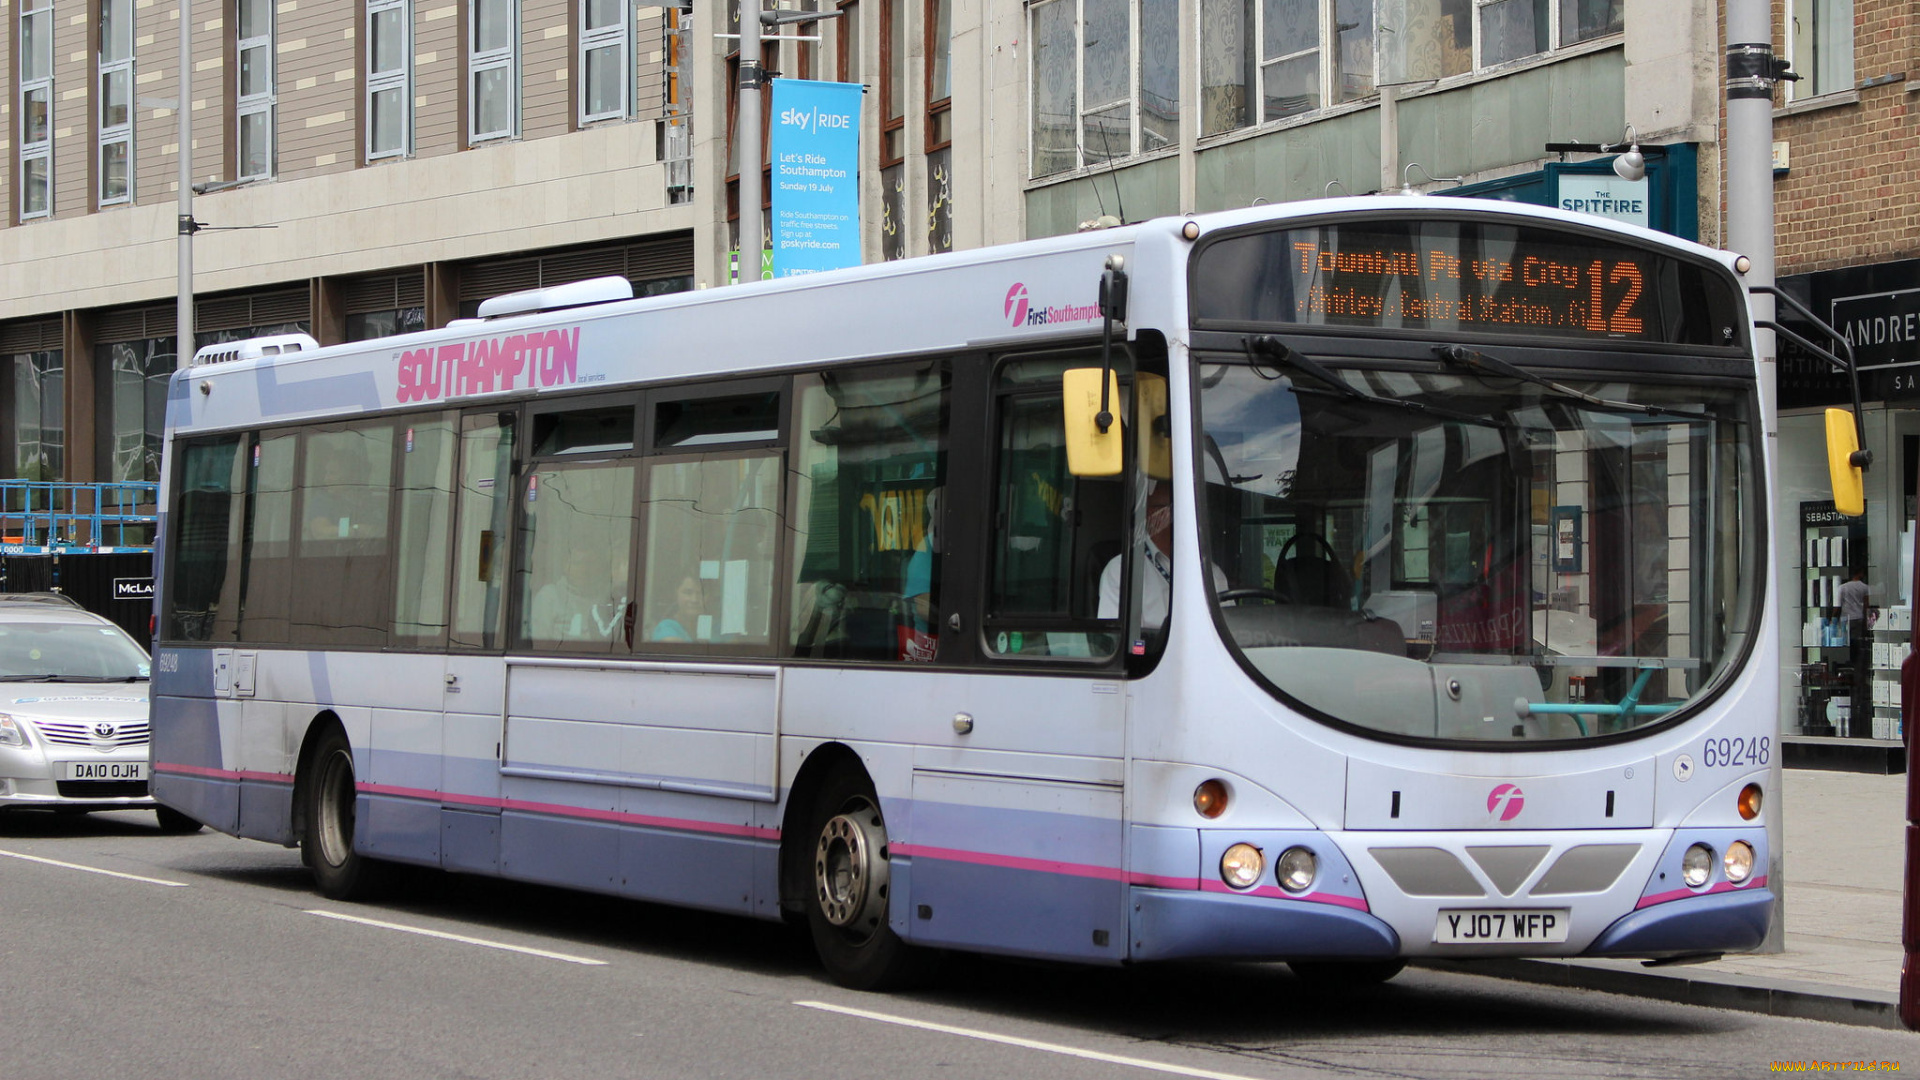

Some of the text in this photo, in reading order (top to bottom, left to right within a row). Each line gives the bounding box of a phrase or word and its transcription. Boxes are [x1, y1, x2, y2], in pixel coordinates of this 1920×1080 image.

[781, 107, 850, 130] sky RIDE
[779, 152, 826, 165] Let's Ride
[779, 164, 846, 179] Southampton
[779, 181, 834, 194] Sunday 19 July
[1562, 199, 1643, 214] SPITFIRE
[794, 211, 839, 222] Southampton
[780, 220, 799, 229] traffic
[800, 221, 814, 229] free
[780, 229, 794, 239] Sign
[795, 231, 804, 239] up
[780, 239, 840, 251] goskyride.com
[1294, 242, 1643, 333] Townhill Pk via City 12
[1401, 289, 1474, 321] Central
[1844, 311, 1920, 347] ANDRE
[396, 327, 580, 403] SOUTHAMPTON
[159, 652, 178, 673] 69248
[1703, 736, 1770, 768] 69248
[75, 763, 139, 778] DA10 OJH
[1448, 914, 1556, 939] YJ07 WFP
